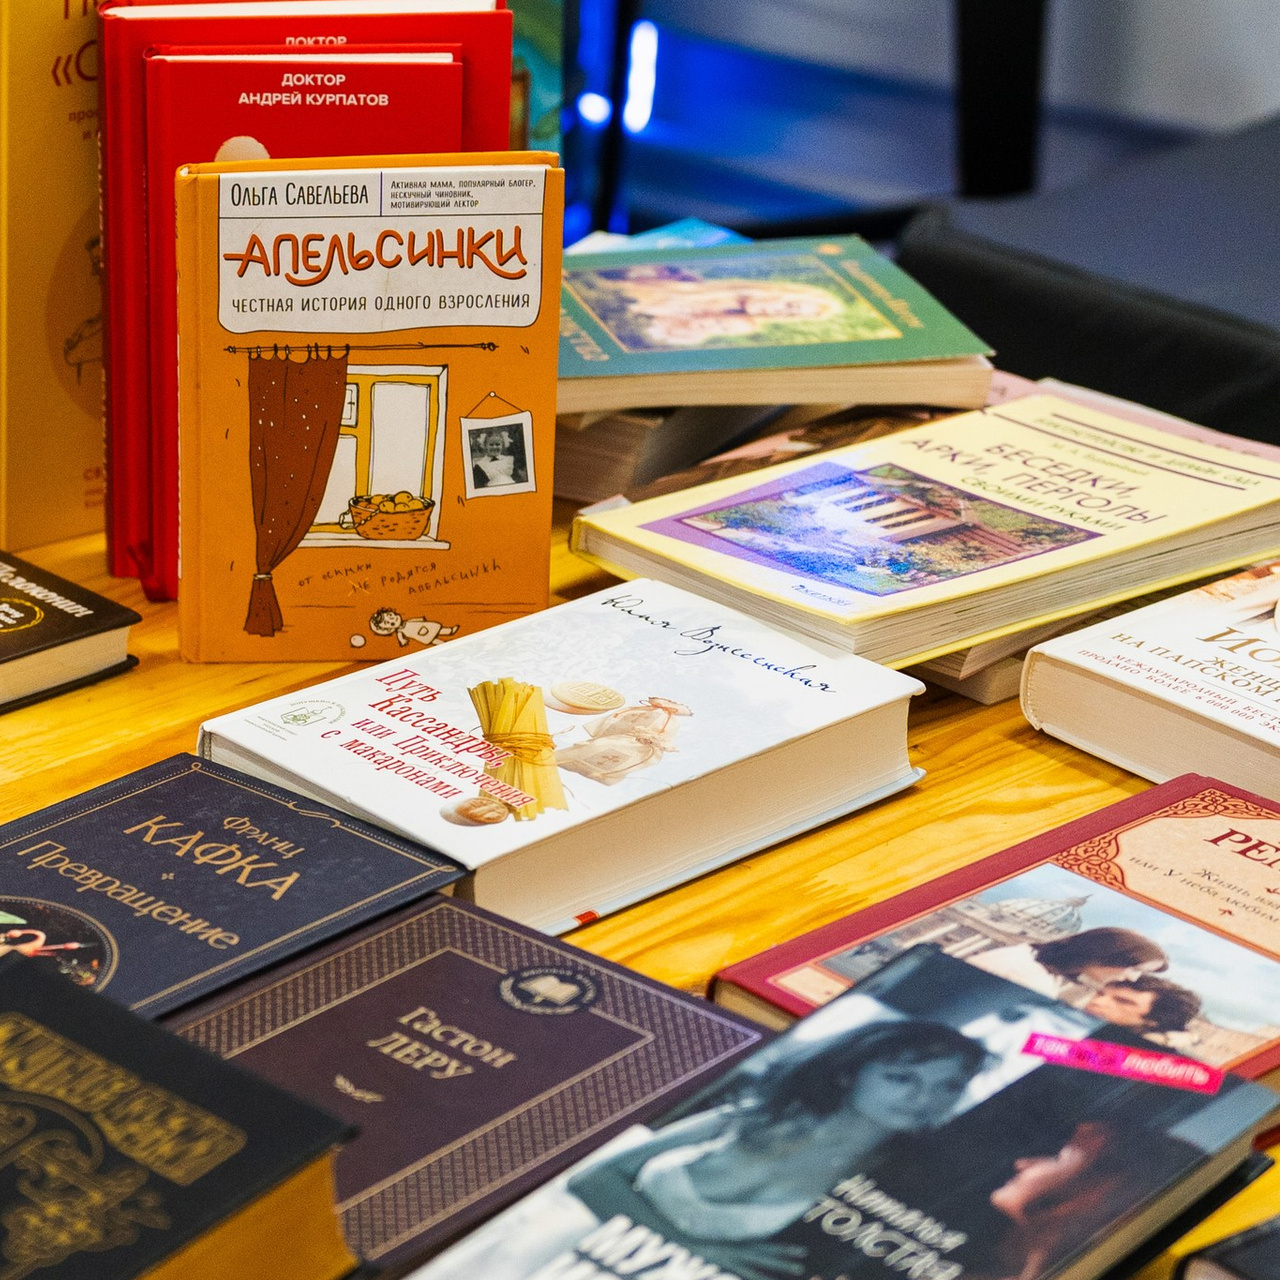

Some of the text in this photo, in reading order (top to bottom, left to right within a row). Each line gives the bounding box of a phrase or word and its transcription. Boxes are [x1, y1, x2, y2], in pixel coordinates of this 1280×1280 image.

[238, 91, 390, 107] АНДРЕЙ КУРПАТОВ
[281, 73, 347, 87] ДОКТОР
[223, 225, 528, 287] АПЕЛЬСИНКИ
[232, 293, 531, 314] ЧЕСТНАЯ ИСТОРИЯ ОДНОГО ВЗРОСЛЕНИЯ
[901, 438, 997, 476] АРКИ,
[1002, 472, 1168, 526] ПЕРГОЛЫ
[985, 442, 1142, 500] БЕСЕДКИ,
[960, 476, 1129, 531] СВОИМИ РУКАМИ
[600, 594, 838, 694] Юлия Вознесенская
[1077, 648, 1144, 677] ПРОДАНО
[1144, 674, 1192, 696] БОЛЕЕ
[1110, 632, 1274, 698] НА ПАПСКОМ
[375, 668, 444, 703] Путь
[1111, 652, 1239, 706] МЕЖДУНАРОДНЫЙ
[368, 693, 514, 769] Кассандры,
[320, 728, 342, 740] с
[338, 737, 465, 801] макаронами
[349, 717, 398, 741] или
[391, 733, 537, 808] Приключения
[123, 814, 302, 902] КАФКА
[1128, 856, 1160, 872] или
[1179, 877, 1219, 898] неба
[1190, 867, 1252, 898] Жизнь
[15, 839, 243, 950] Превращение
[365, 1031, 475, 1080] ЛЕРУ
